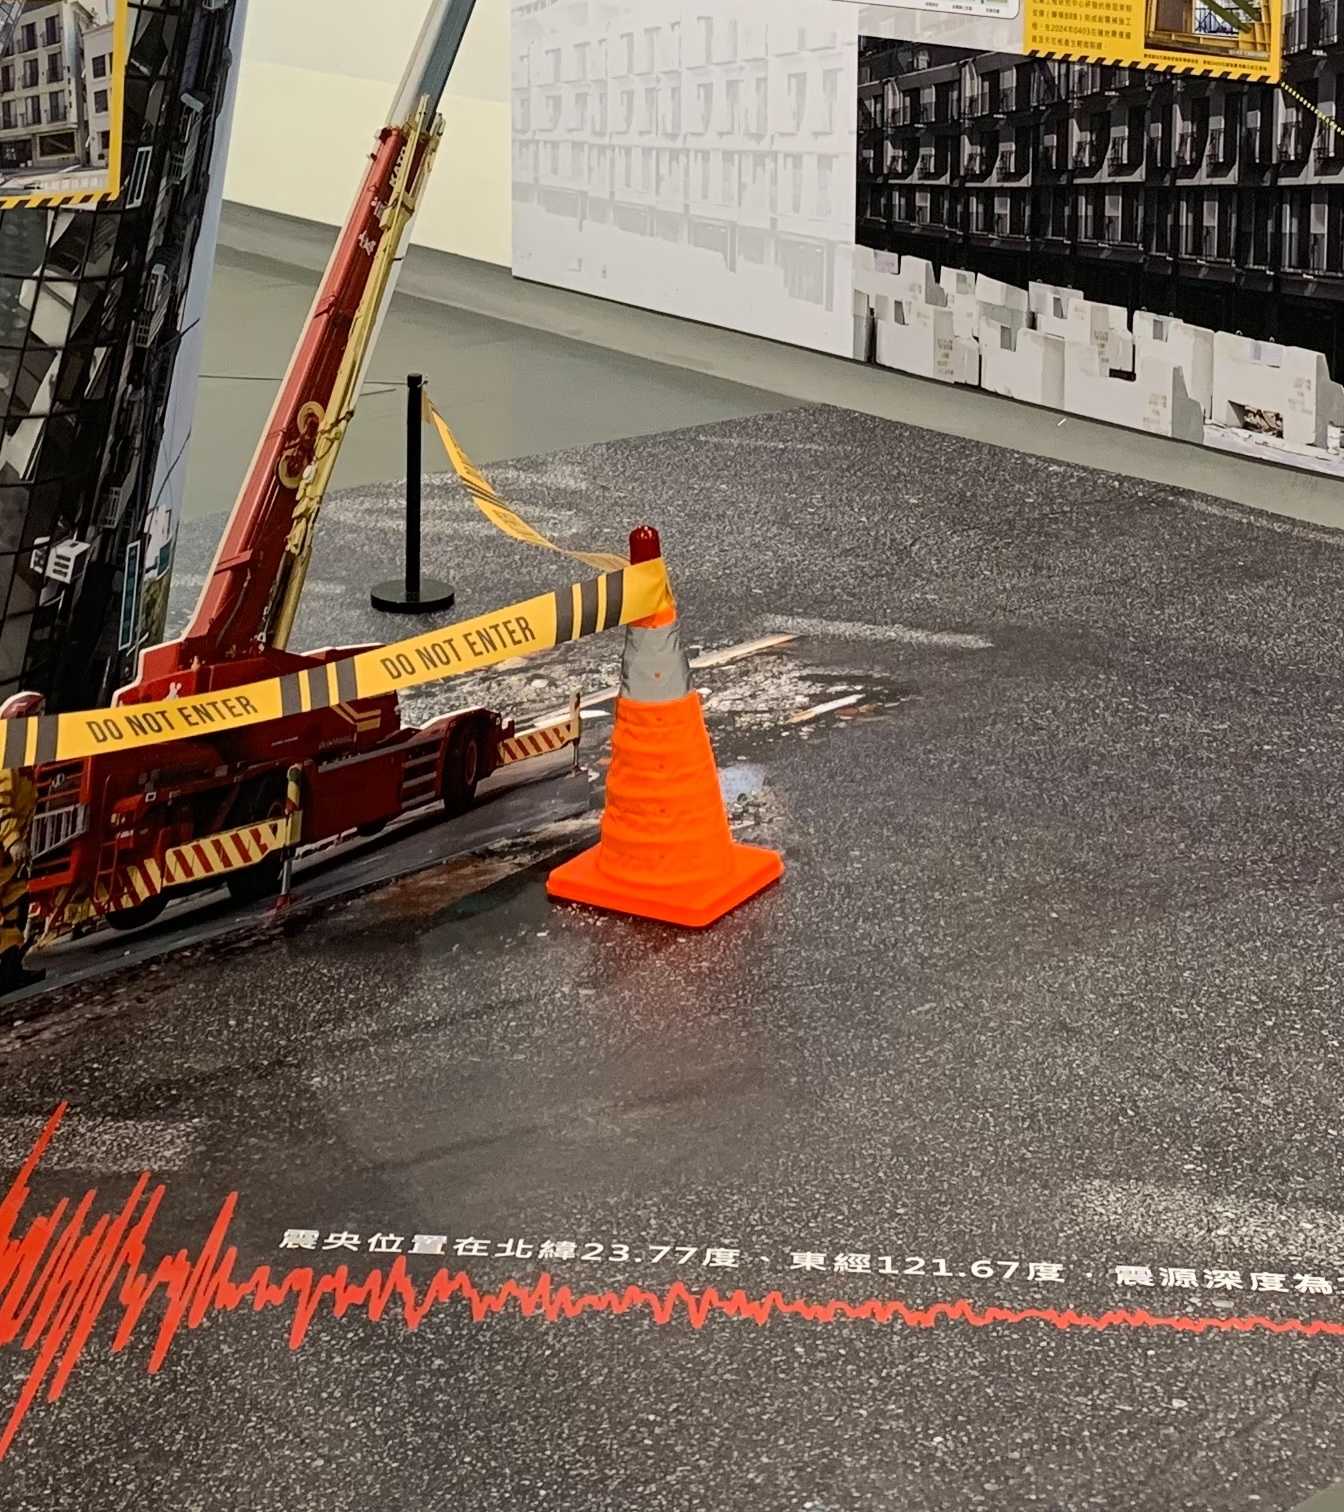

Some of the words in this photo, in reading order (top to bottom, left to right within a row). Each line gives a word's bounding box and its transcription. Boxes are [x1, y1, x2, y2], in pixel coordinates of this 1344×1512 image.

[380, 654, 415, 679] DO
[415, 638, 461, 670] NOT
[463, 617, 536, 656] ENTER
[87, 720, 123, 743] DO
[125, 711, 174, 735] NOT
[178, 696, 257, 726] ENTER
